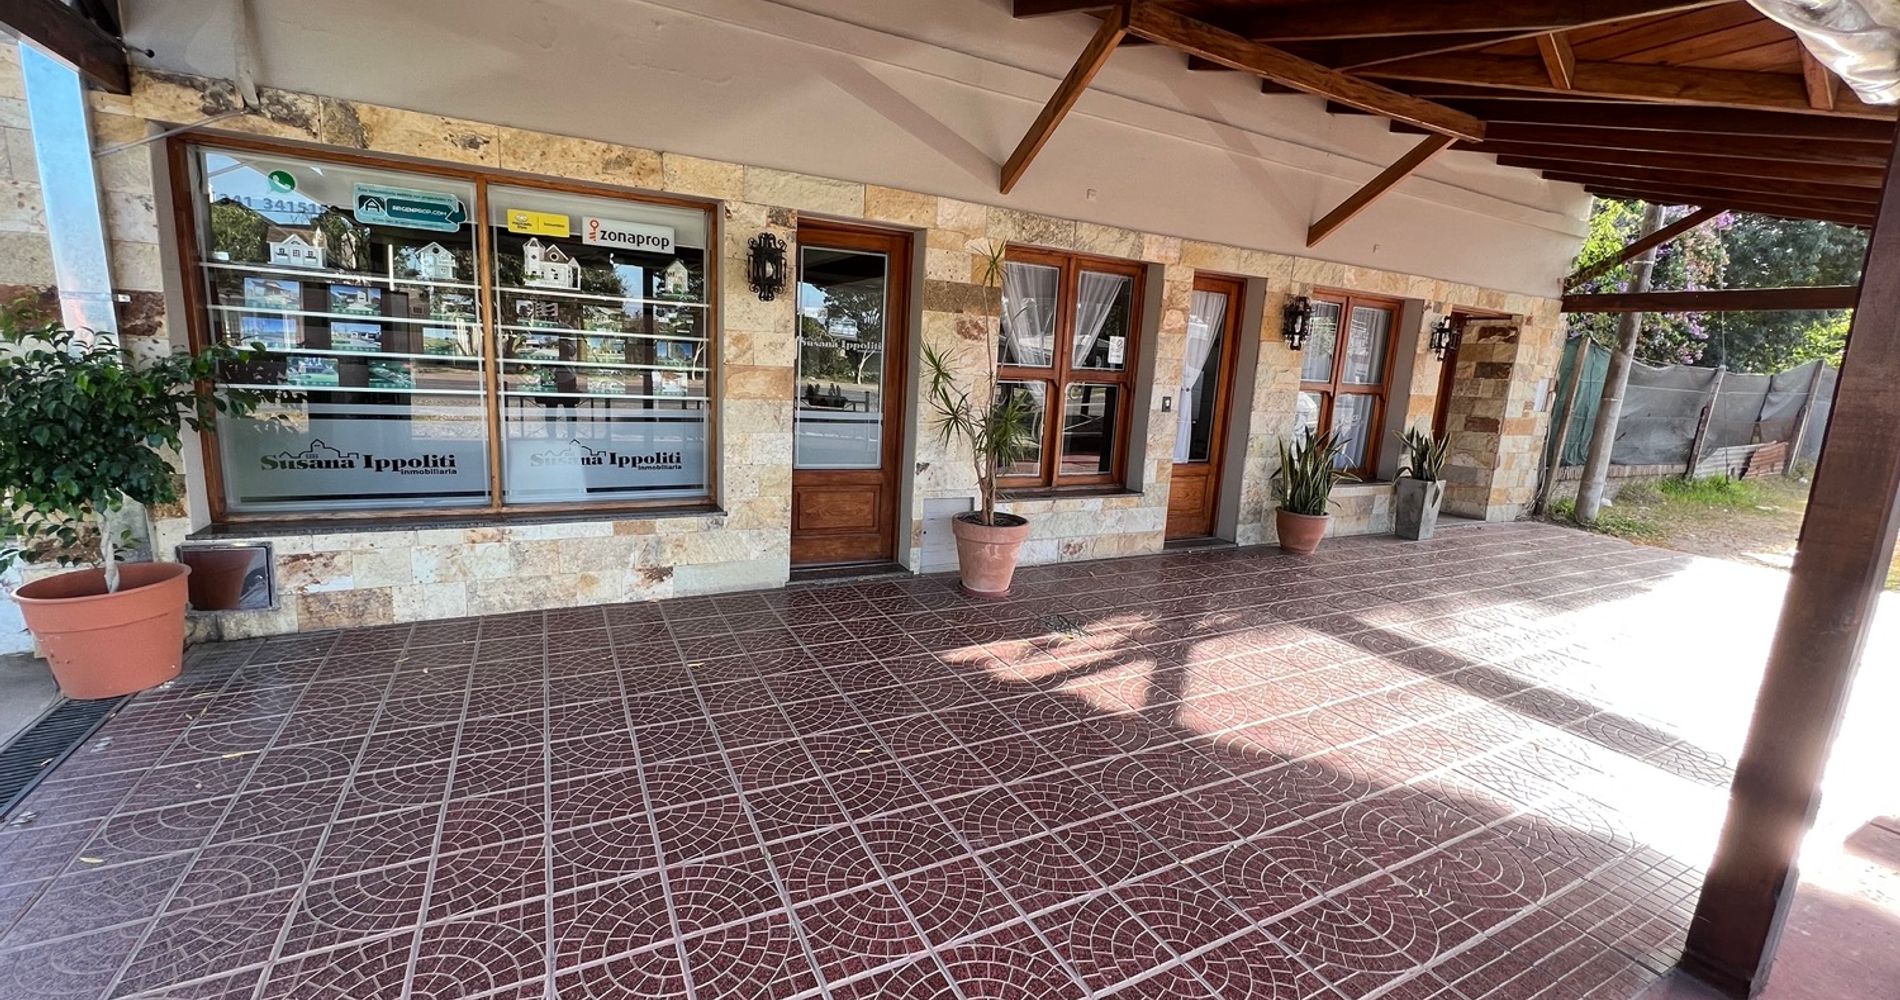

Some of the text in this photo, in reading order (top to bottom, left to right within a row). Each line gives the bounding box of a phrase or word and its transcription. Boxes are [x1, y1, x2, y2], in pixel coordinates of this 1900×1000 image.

[600, 229, 670, 249] zonaprop
[261, 454, 456, 473] Susana Ippoliti
[609, 452, 681, 468] Ippoliti
